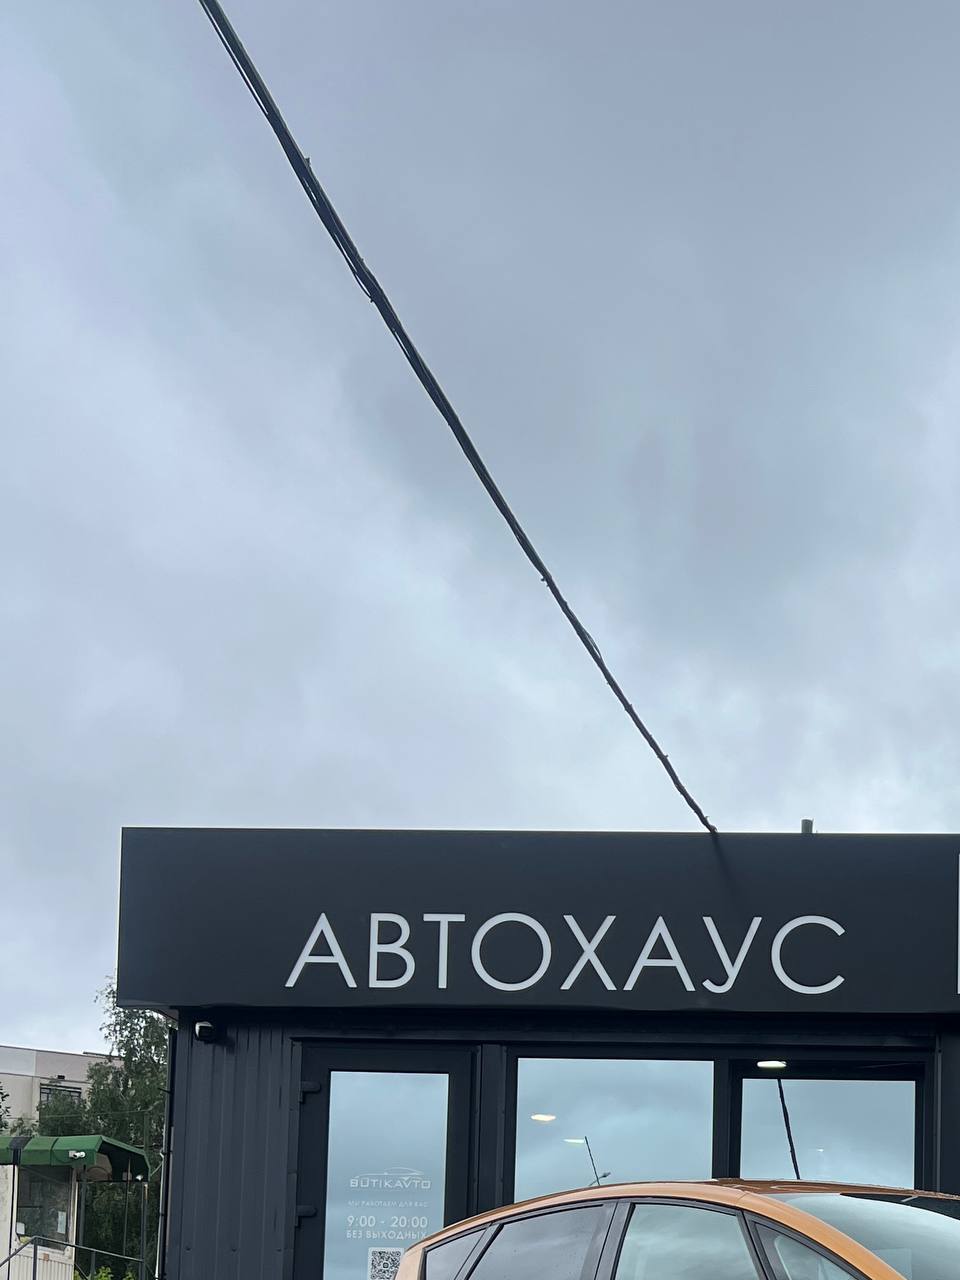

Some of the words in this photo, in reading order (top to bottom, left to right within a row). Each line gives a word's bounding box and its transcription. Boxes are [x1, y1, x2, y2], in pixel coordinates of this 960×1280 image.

[285, 912, 846, 995] АВТОХАУС
[350, 1178, 431, 1189] BUTIKAVTO
[347, 1215, 376, 1228] 9:00
[391, 1216, 428, 1228] 20:00
[346, 1230, 363, 1239] БЕЗ
